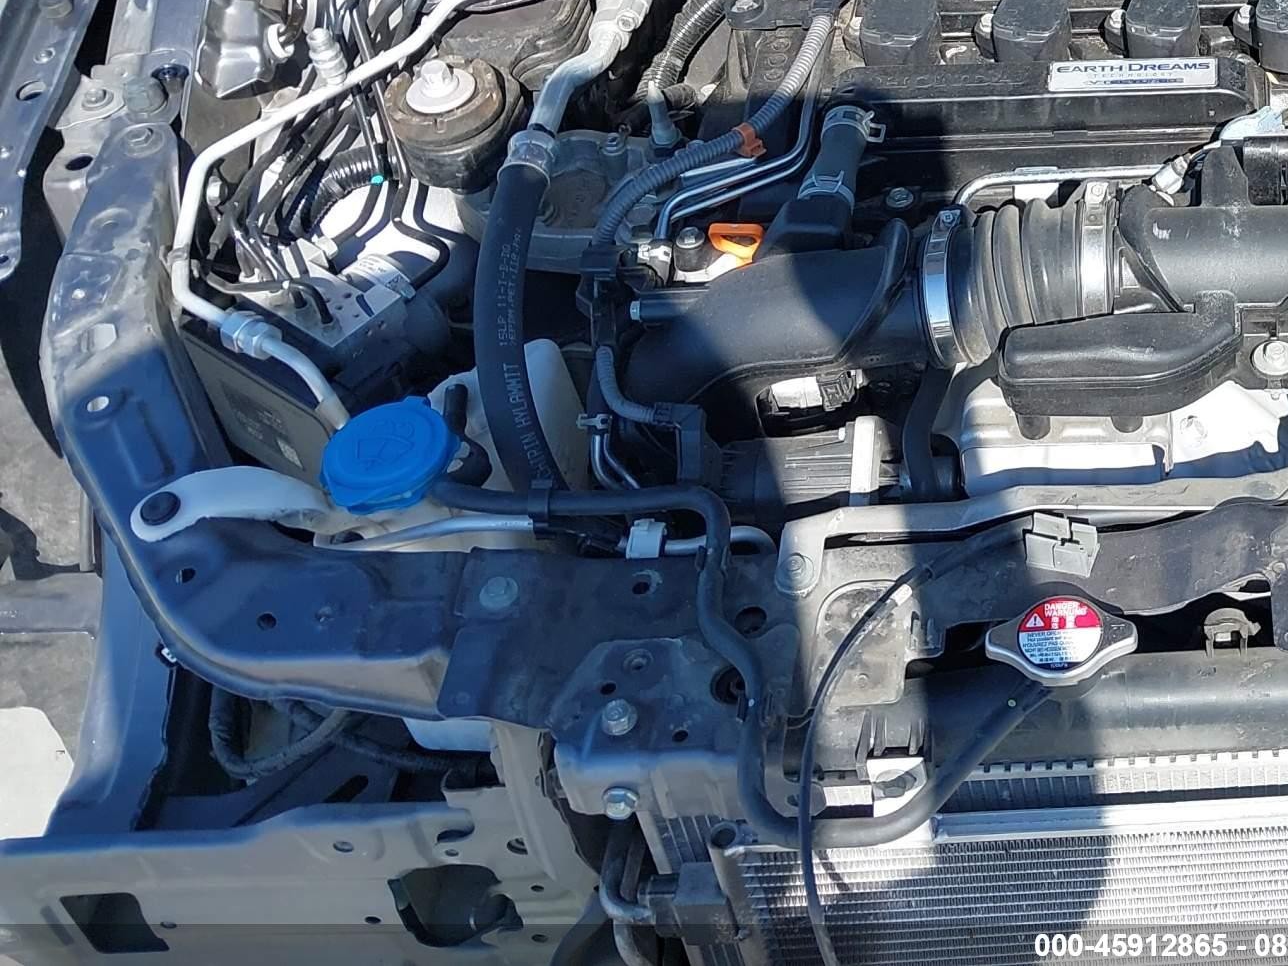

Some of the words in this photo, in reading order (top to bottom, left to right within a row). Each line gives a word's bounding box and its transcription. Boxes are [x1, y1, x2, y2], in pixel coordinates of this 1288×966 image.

[1056, 65, 1123, 74] EARTH
[1128, 62, 1210, 71] DREAMS
[1044, 601, 1080, 611] DANGER
